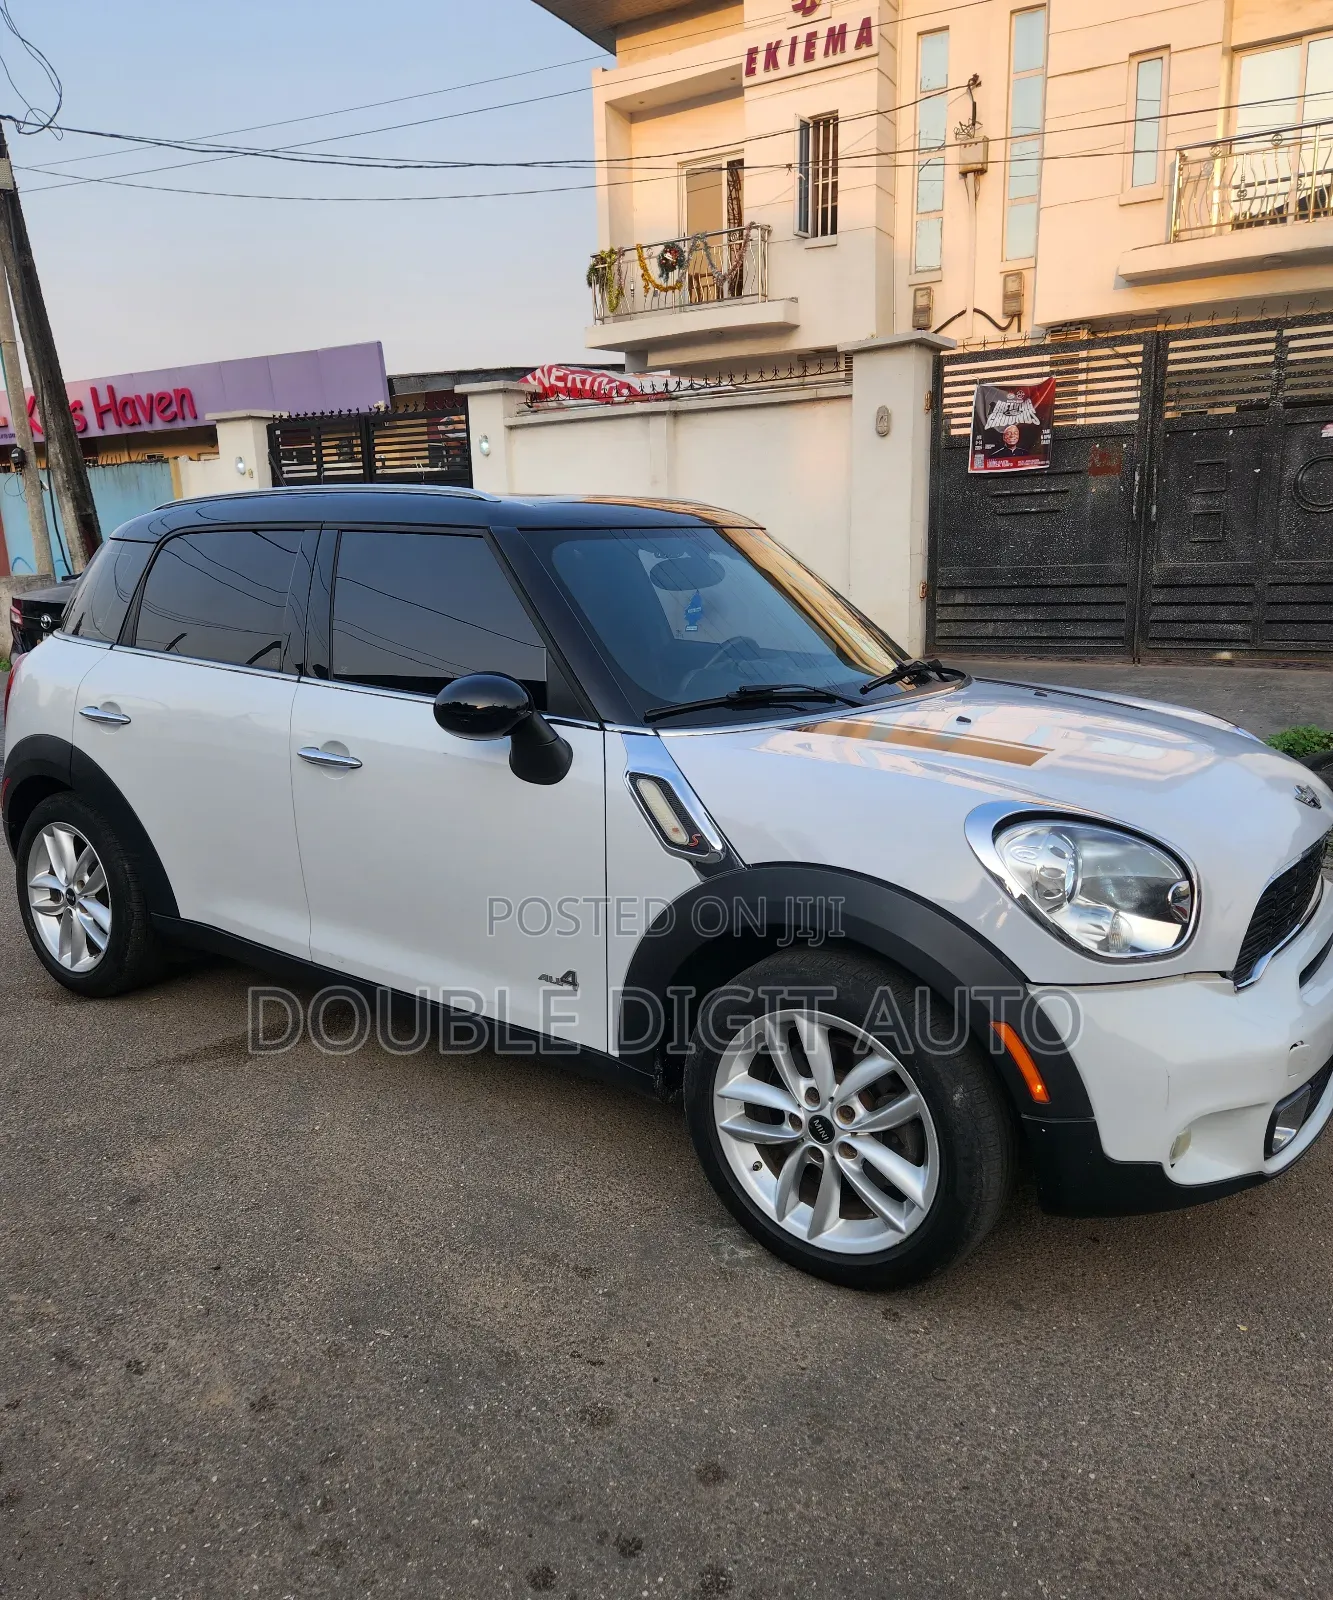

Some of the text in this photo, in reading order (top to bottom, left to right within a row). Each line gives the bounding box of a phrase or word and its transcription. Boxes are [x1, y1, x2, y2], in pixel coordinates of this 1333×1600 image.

[745, 16, 873, 77] EKIEMA
[26, 384, 198, 437] Ks Haven
[813, 1119, 829, 1141] MINI
